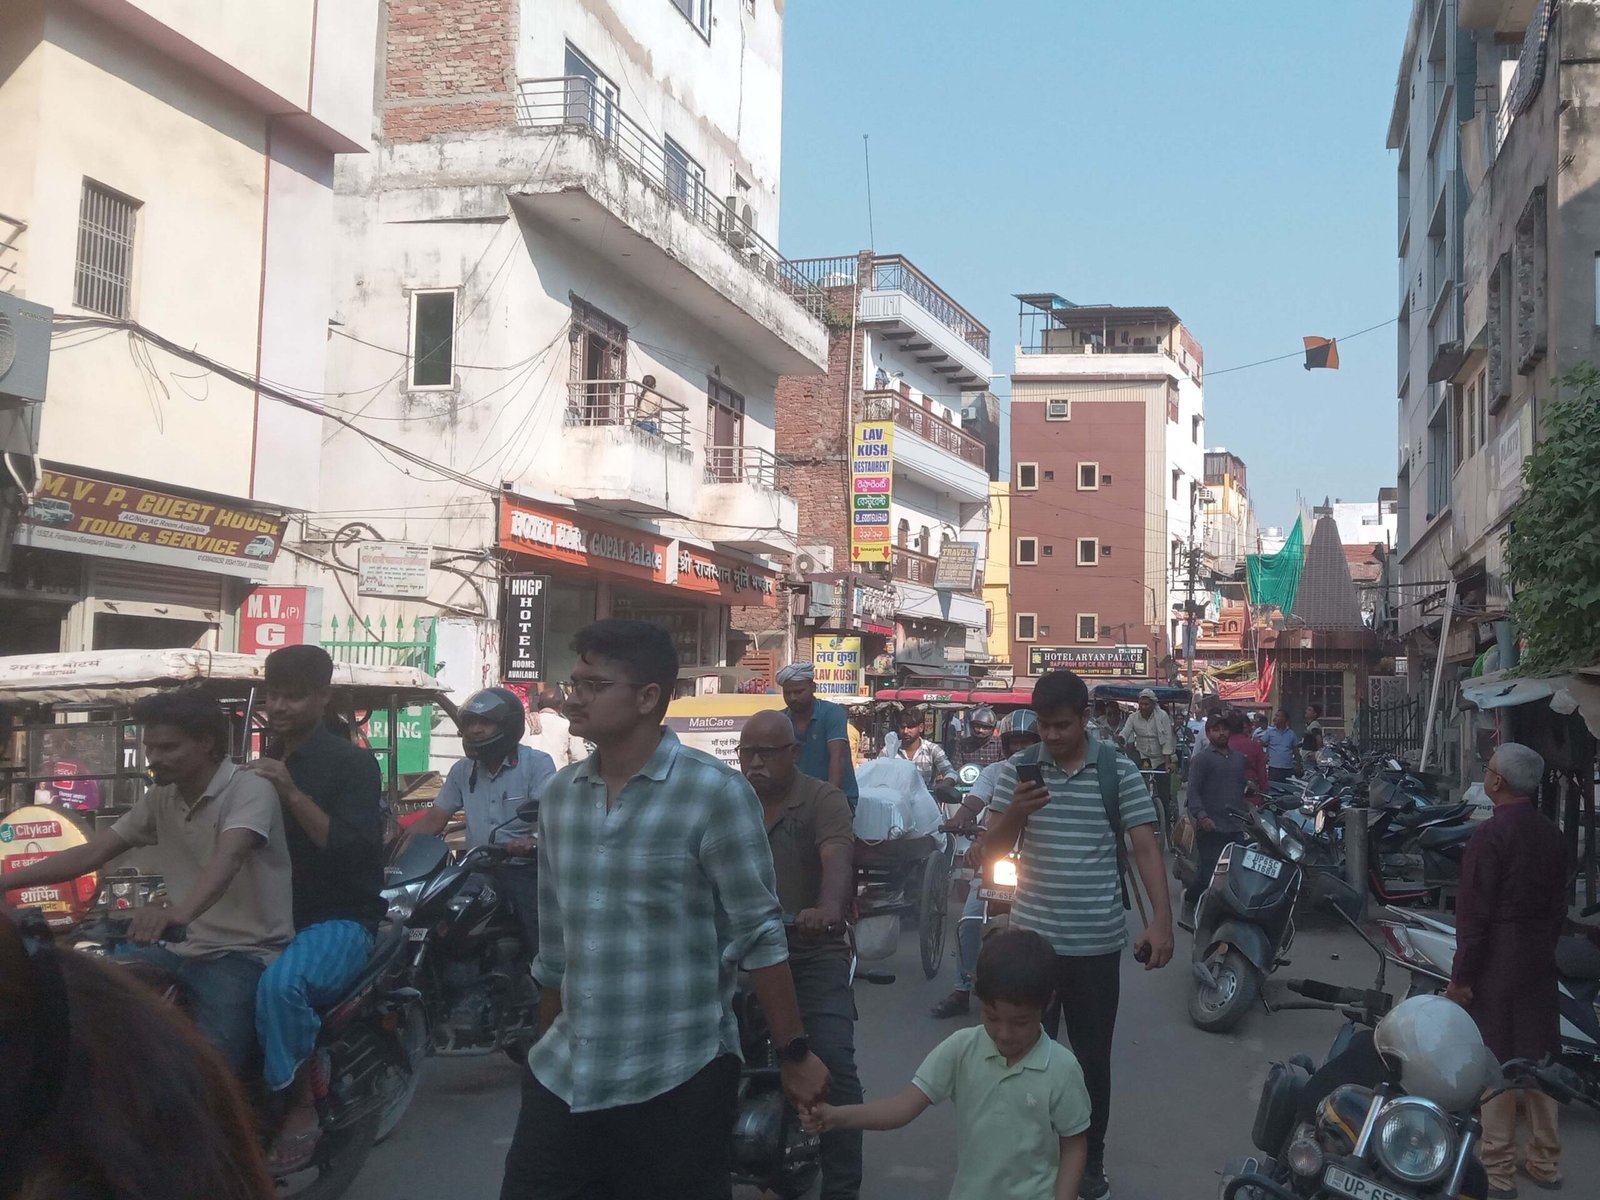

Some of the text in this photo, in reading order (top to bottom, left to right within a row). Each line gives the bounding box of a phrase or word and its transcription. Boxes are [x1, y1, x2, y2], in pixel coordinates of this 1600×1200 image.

[863, 429, 883, 440] LAV
[858, 444, 888, 456] KUSH
[854, 461, 890, 473] RESTAURENT
[136, 494, 215, 522] GUEST
[160, 520, 178, 528] Room
[178, 523, 205, 532] Available
[77, 516, 137, 540] TOUR
[139, 532, 150, 542] &
[155, 531, 240, 556] SERVICE
[592, 532, 626, 561] GOPAL
[628, 541, 662, 570] Palace
[679, 550, 693, 573] श्री
[694, 560, 730, 582] राजस्थान
[512, 580, 542, 595] HHGP
[519, 597, 532, 659] HOTEL
[256, 624, 285, 646] G
[816, 651, 858, 667] लव कुश
[1044, 652, 1142, 661] HOTEL ARYAN PALACE
[512, 660, 535, 668] ROOMS
[508, 671, 539, 679] AVAILABLE
[815, 669, 857, 681] LAV KUSH
[816, 683, 857, 694] RESTAURENT
[689, 718, 734, 727] MatCare
[15, 823, 57, 838] Citykart
